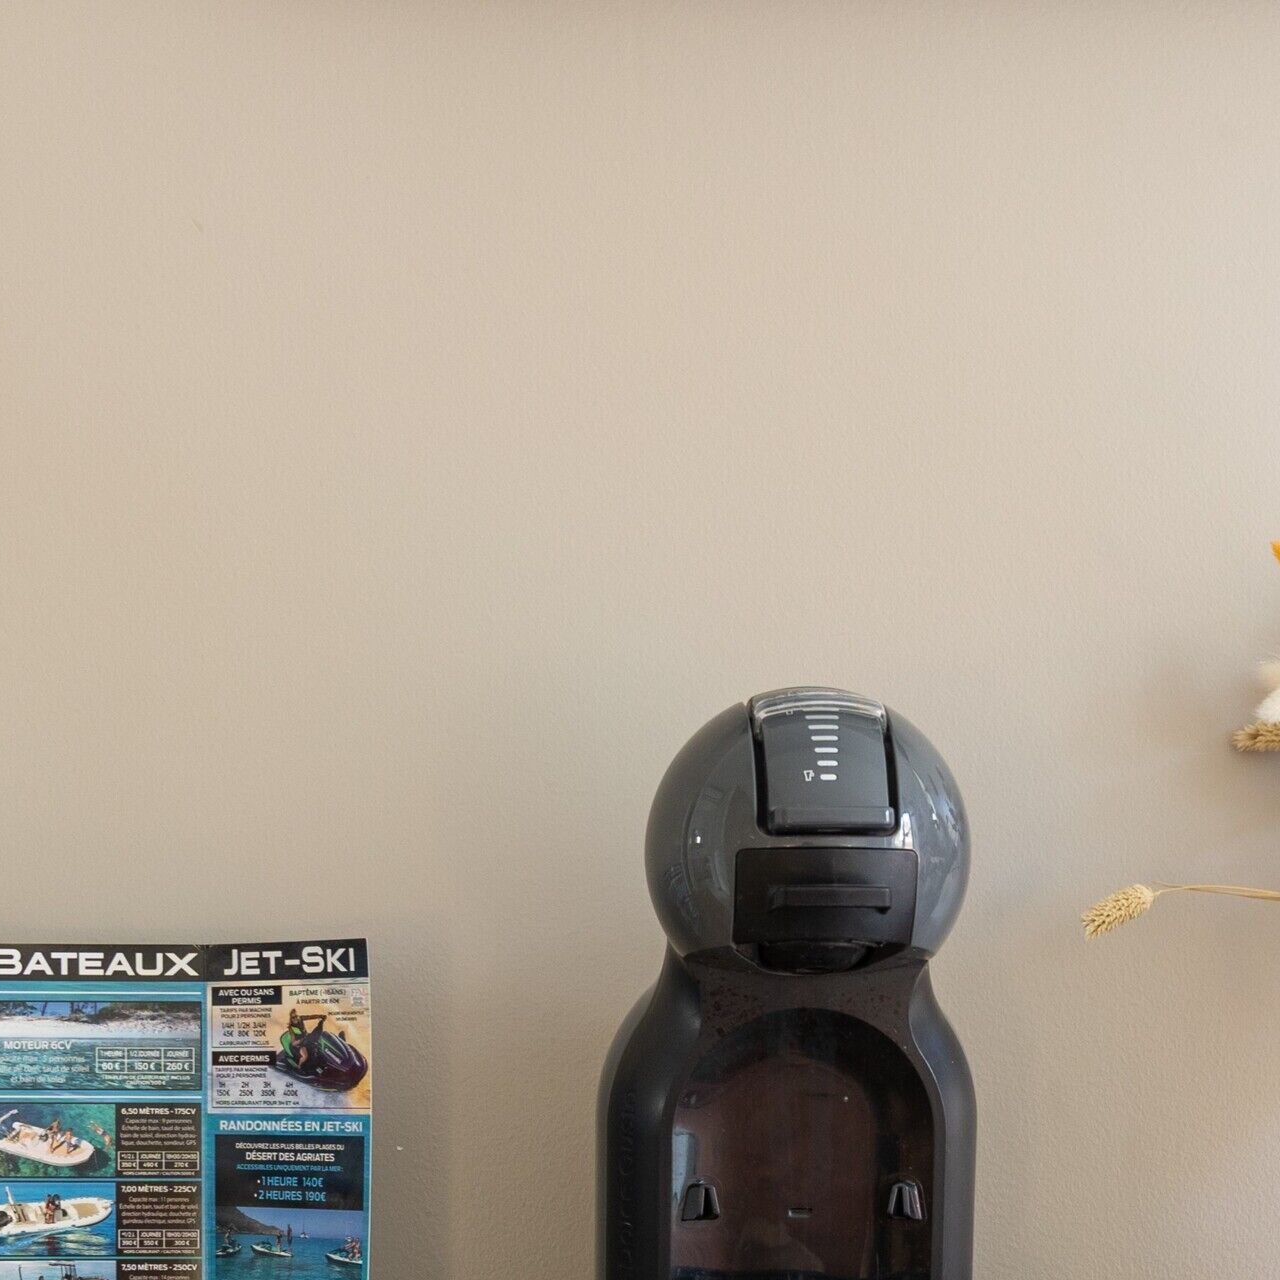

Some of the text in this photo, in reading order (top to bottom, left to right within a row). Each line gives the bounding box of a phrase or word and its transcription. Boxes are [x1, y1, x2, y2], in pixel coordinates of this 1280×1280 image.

[224, 946, 355, 975] JET-SKI
[4, 1041, 49, 1049] MOTEUR
[220, 1119, 362, 1132] RANDONNÉES EN JET-SKI
[246, 1150, 335, 1161] DÉSERT DES AGRIATES
[267, 1177, 298, 1187] HEURE
[303, 1178, 323, 1187] 140€
[259, 1191, 326, 1201] 2 HEURES 190€
